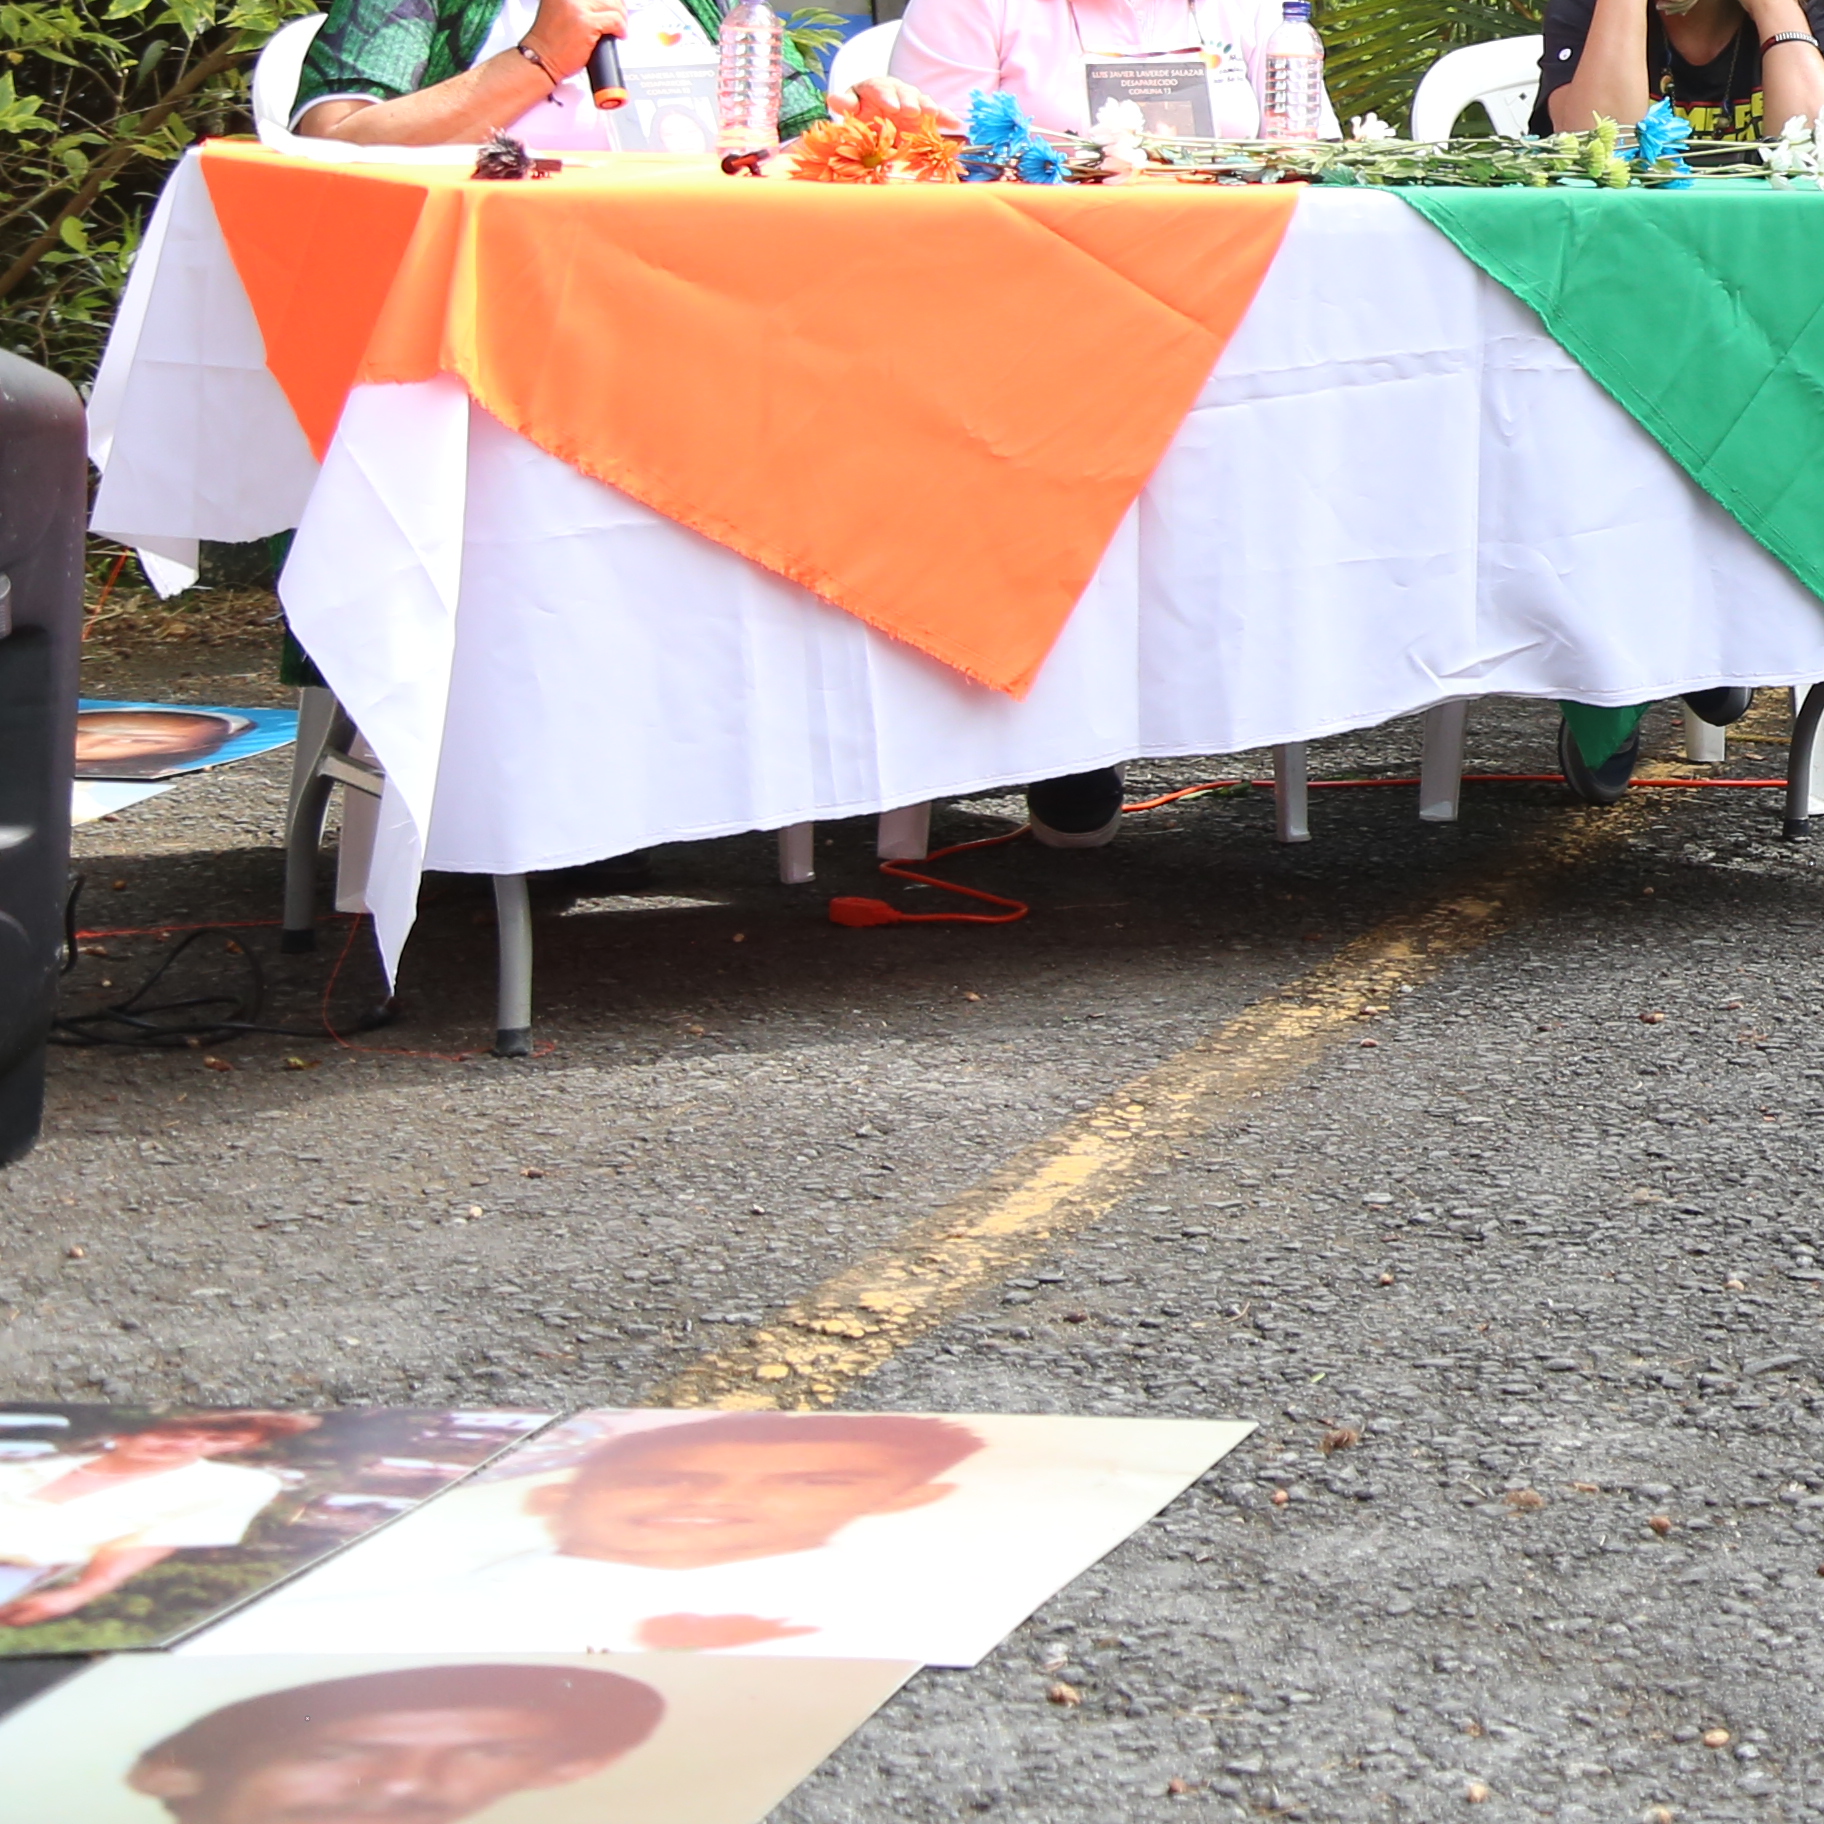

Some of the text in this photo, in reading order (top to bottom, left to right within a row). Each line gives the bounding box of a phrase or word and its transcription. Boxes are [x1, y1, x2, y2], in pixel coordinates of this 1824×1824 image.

[1091, 68, 1205, 79] LUIS JAVIER LAVERDE SALAZAR
[1120, 78, 1178, 87] DESAPARECIDO
[1128, 87, 1163, 96] COMUNA
